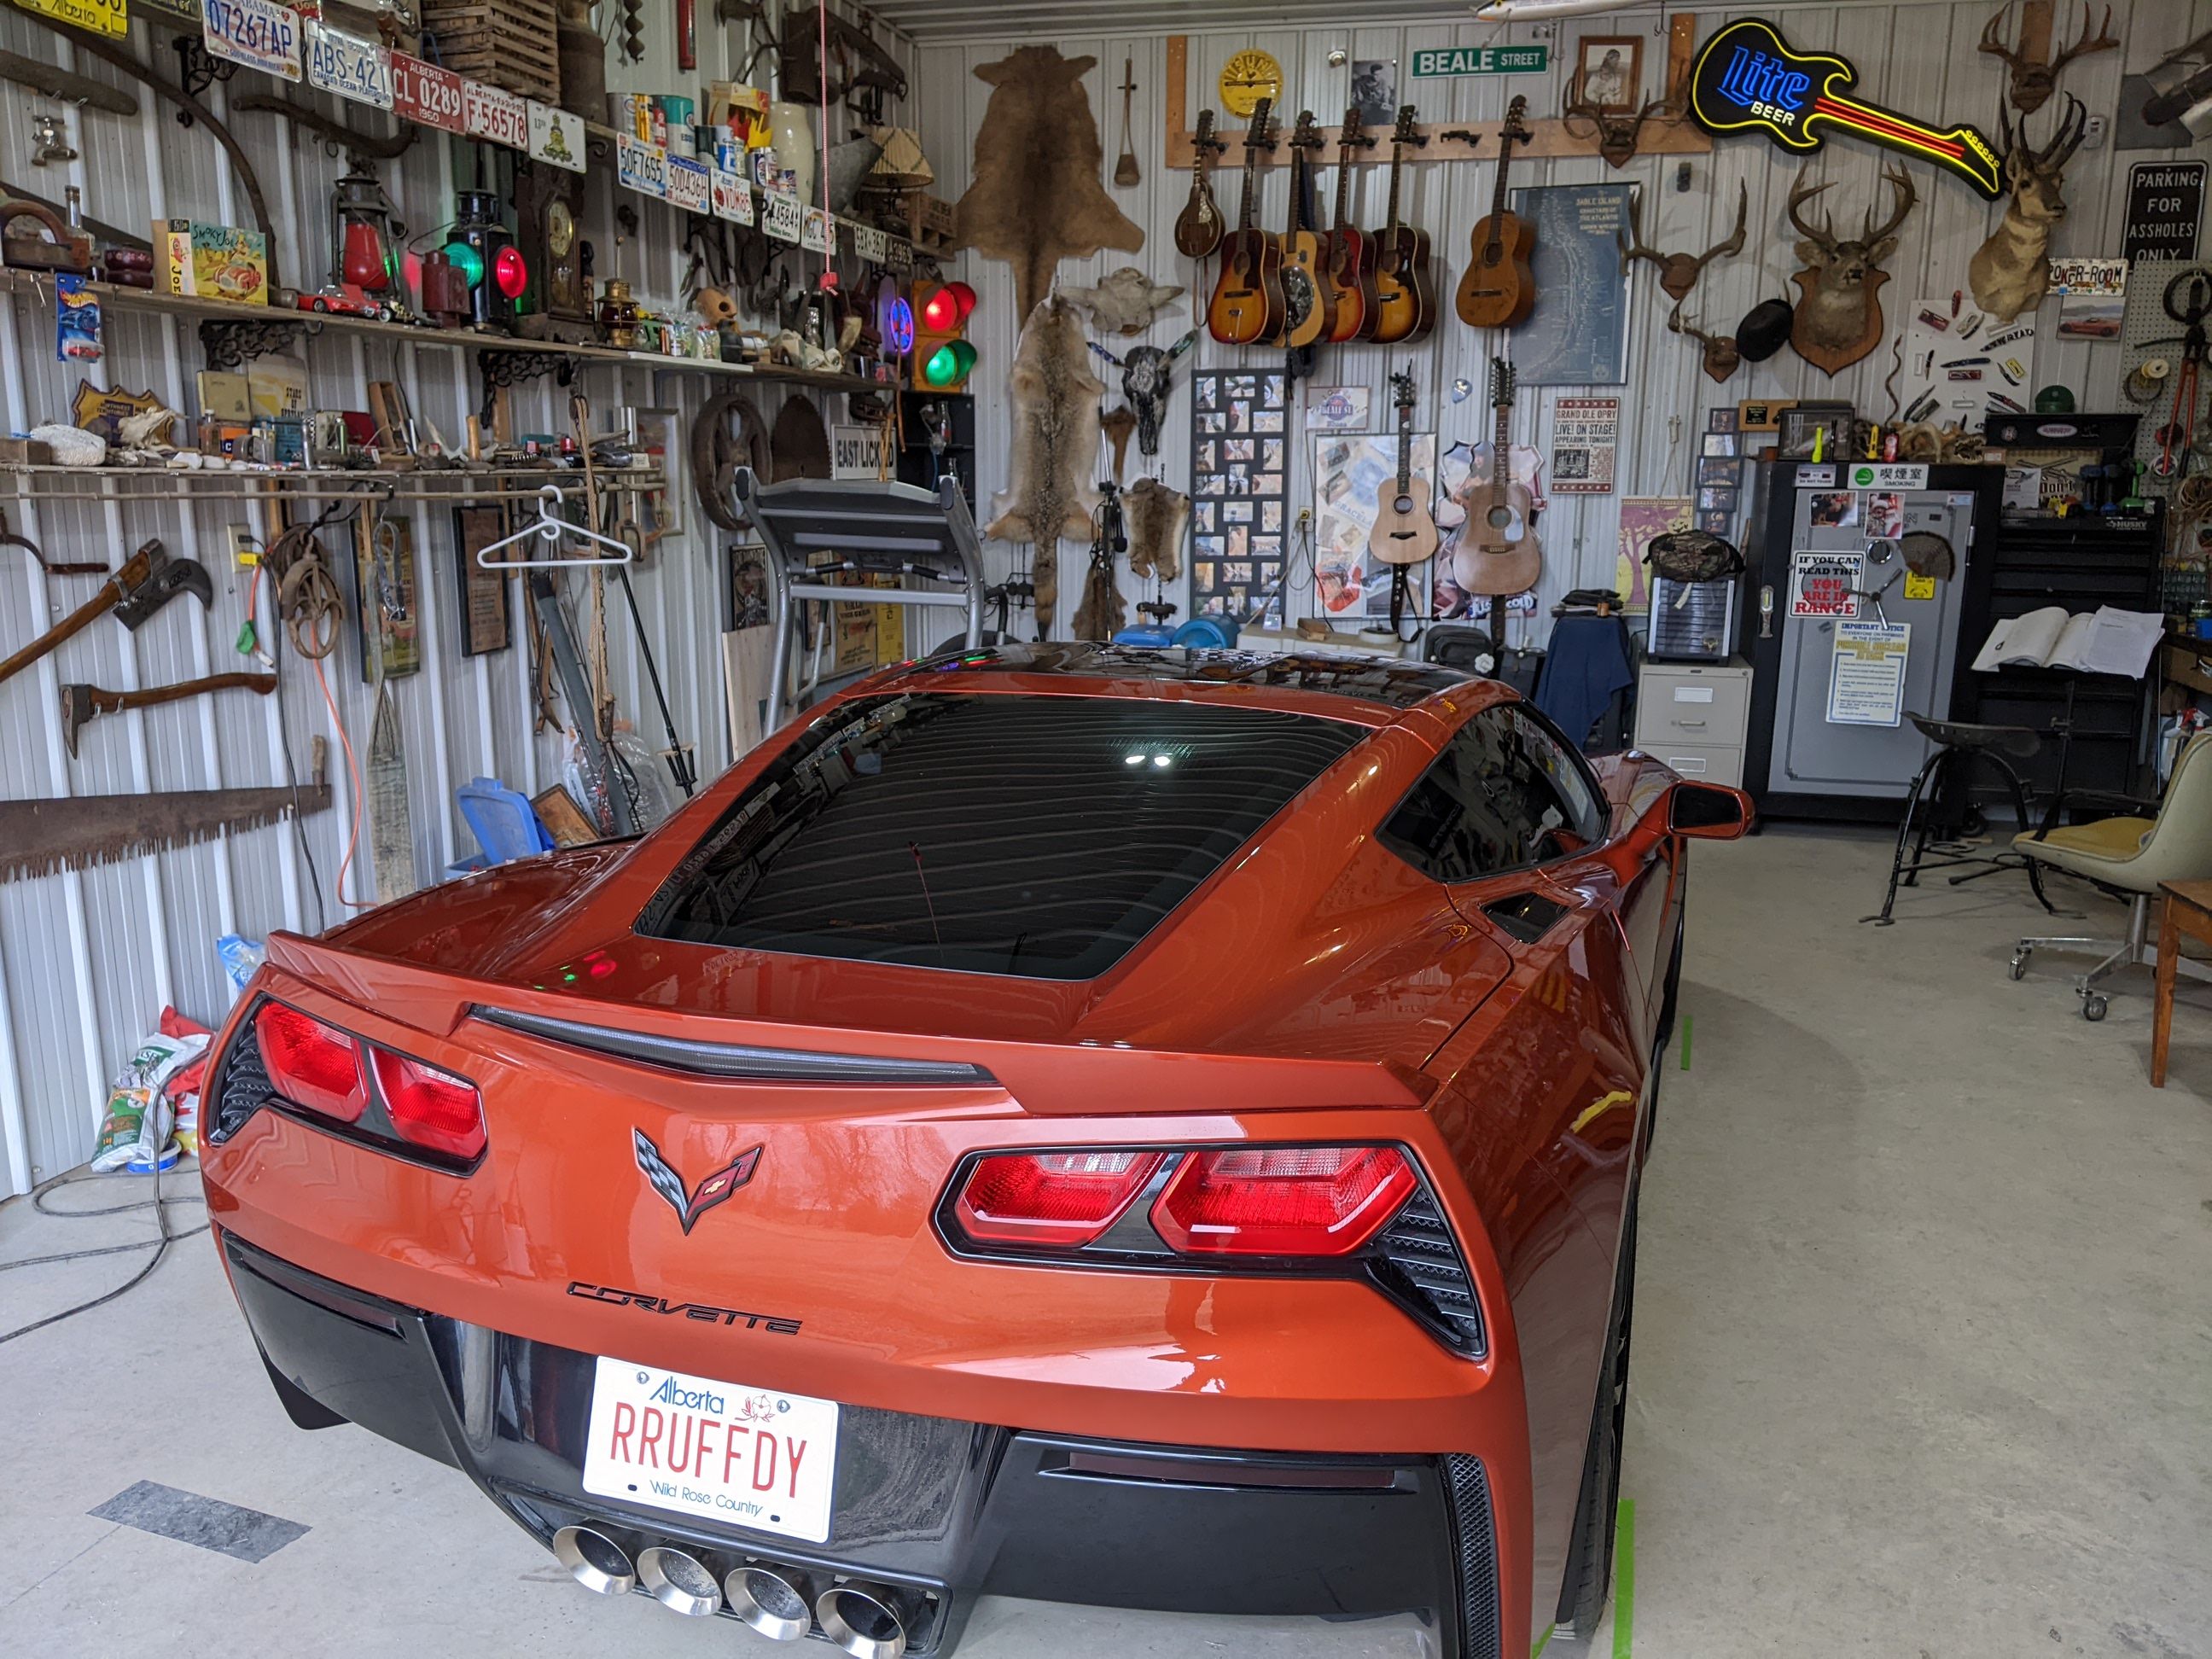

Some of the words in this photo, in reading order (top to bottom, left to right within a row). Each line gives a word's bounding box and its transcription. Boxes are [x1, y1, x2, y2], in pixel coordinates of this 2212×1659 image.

[209, 2, 291, 58] 07267AP
[312, 39, 386, 95] ABS-421
[1419, 49, 1494, 74] BEALE
[1500, 52, 1540, 67] STREET
[410, 62, 444, 82] ALBERTA
[1717, 45, 1811, 110] Lite
[393, 68, 414, 104] CL
[419, 78, 461, 117] 0289
[418, 108, 440, 123] 1960
[1750, 101, 1796, 126] BEER
[2136, 172, 2199, 188] PARKING
[2147, 198, 2181, 212] FOR
[2128, 223, 2194, 238] ASSHOLES
[2136, 248, 2181, 261] ONLY
[172, 265, 182, 293] JOE
[1556, 410, 1580, 418] GRAND
[1582, 410, 1595, 418] OLE
[1597, 410, 1616, 418] OPRY
[1555, 424, 1574, 435] LIVE!
[1576, 424, 1586, 434] ON
[1589, 424, 1615, 435] STAGE!
[1588, 435, 1615, 444] TONIGHT!
[837, 440, 859, 468] EAST
[861, 440, 881, 468] LICK
[1880, 468, 1922, 480] 喫煙室
[1811, 579, 1843, 589] YOU
[1802, 591, 1831, 602] ARE
[1795, 602, 1855, 614] RANGE
[566, 1281, 803, 1336] CORVETTE
[649, 1376, 725, 1414] Alberta
[609, 1401, 807, 1498] RRUFFDY
[649, 1480, 677, 1497] Wild
[682, 1487, 711, 1504] Rose
[716, 1494, 763, 1516] Country
